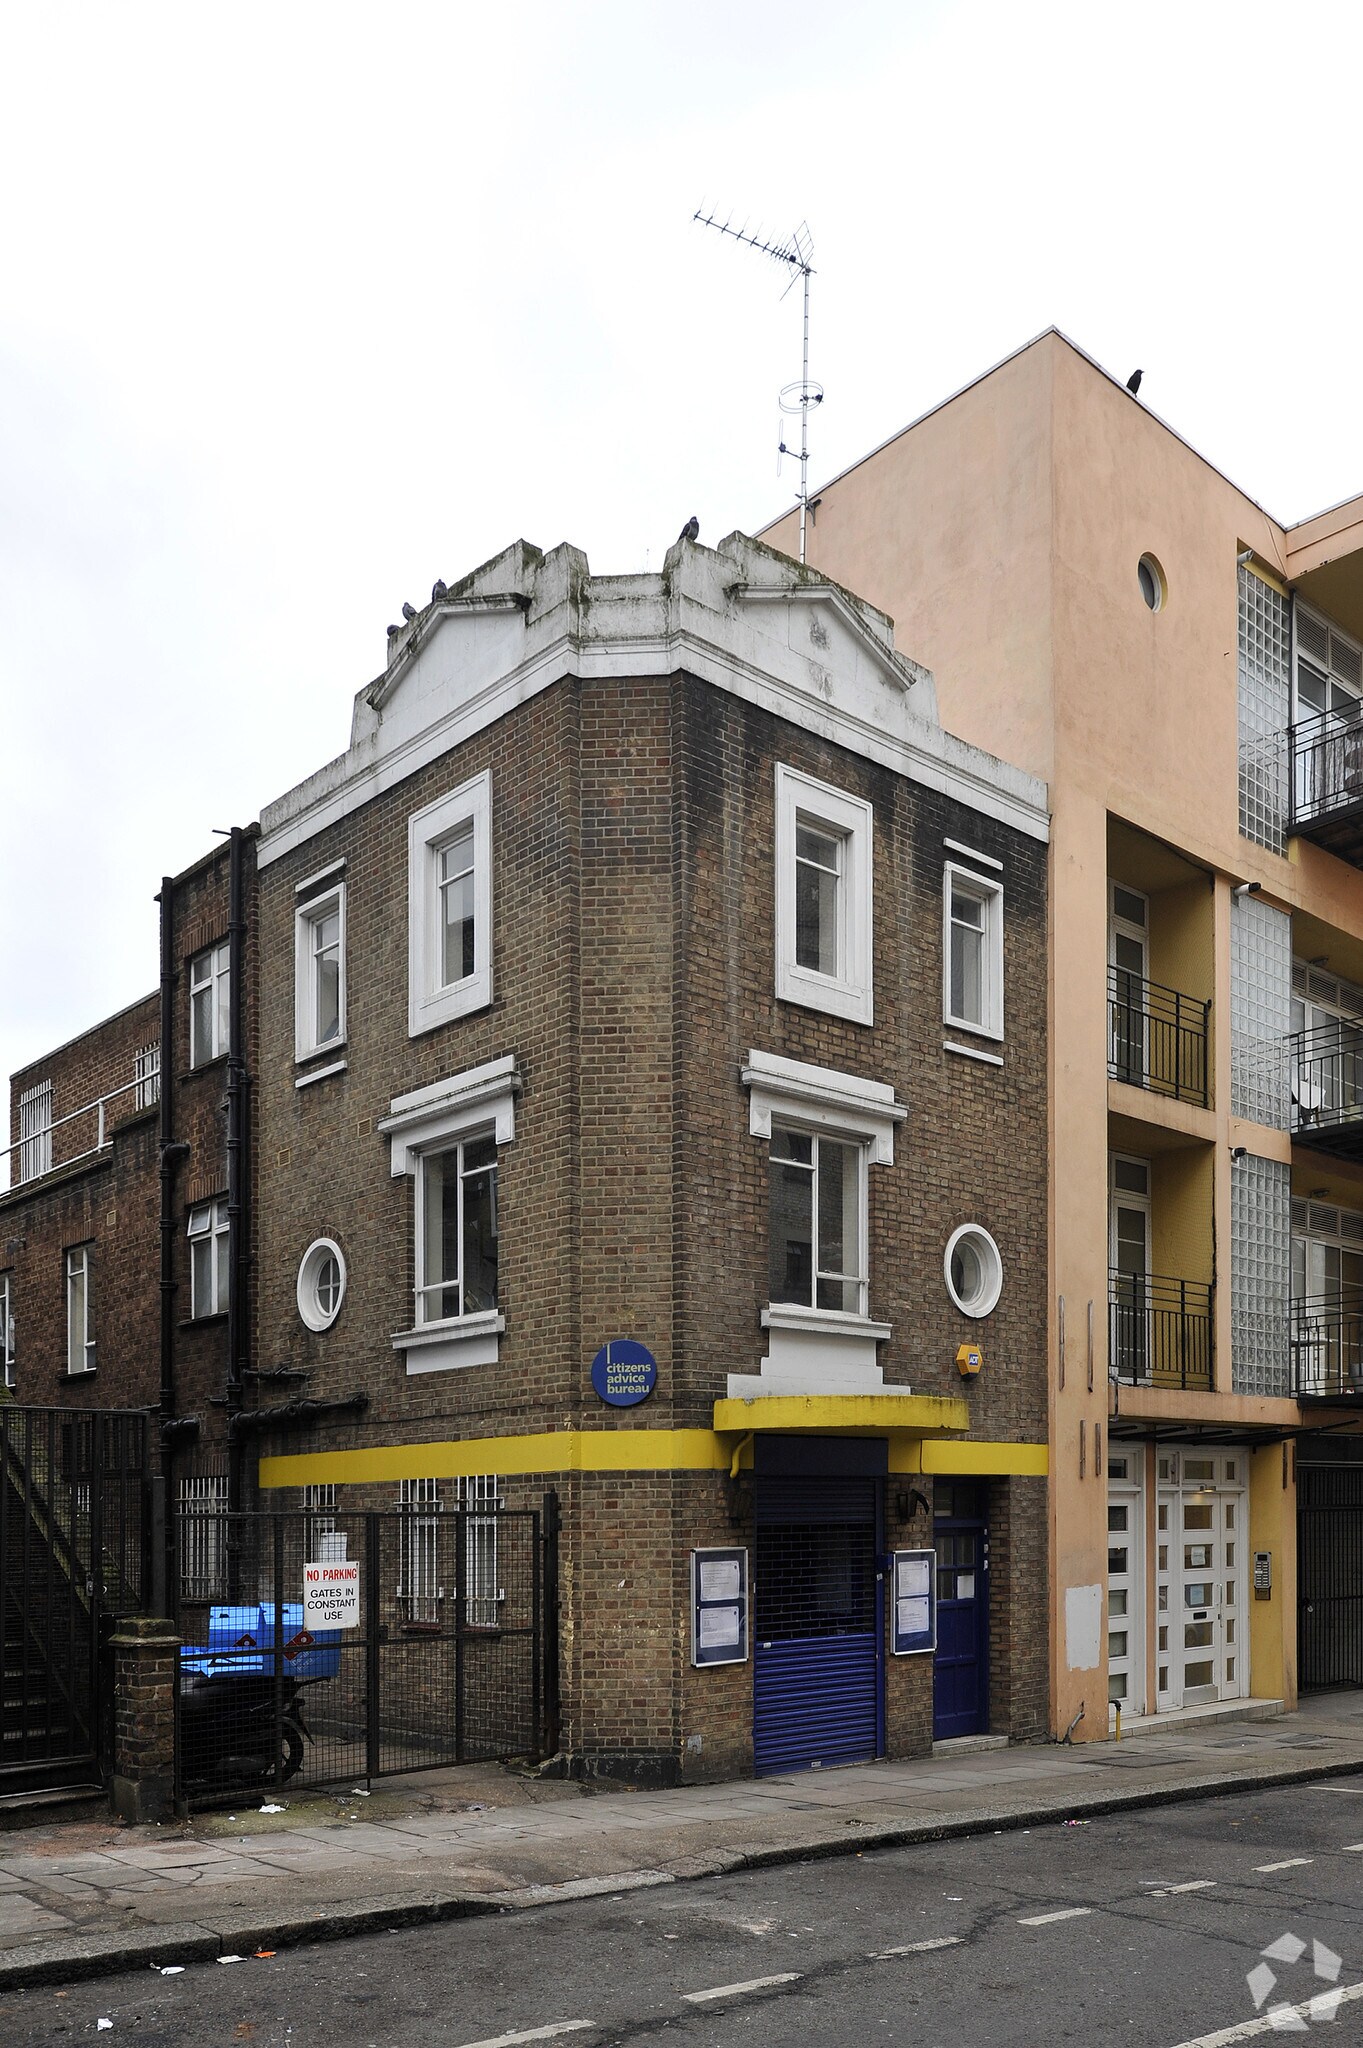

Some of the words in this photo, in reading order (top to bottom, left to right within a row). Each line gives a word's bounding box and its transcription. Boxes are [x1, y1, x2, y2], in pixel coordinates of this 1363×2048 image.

[606, 1362, 651, 1373] citizens
[606, 1373, 645, 1384] advice
[607, 1384, 649, 1394] bureau
[306, 1569, 320, 1581] NO
[323, 1568, 357, 1580] PARKING
[310, 1588, 342, 1598] GATES
[345, 1587, 354, 1596] IN
[307, 1598, 356, 1610] CONSTANT
[324, 1611, 343, 1620] USE
